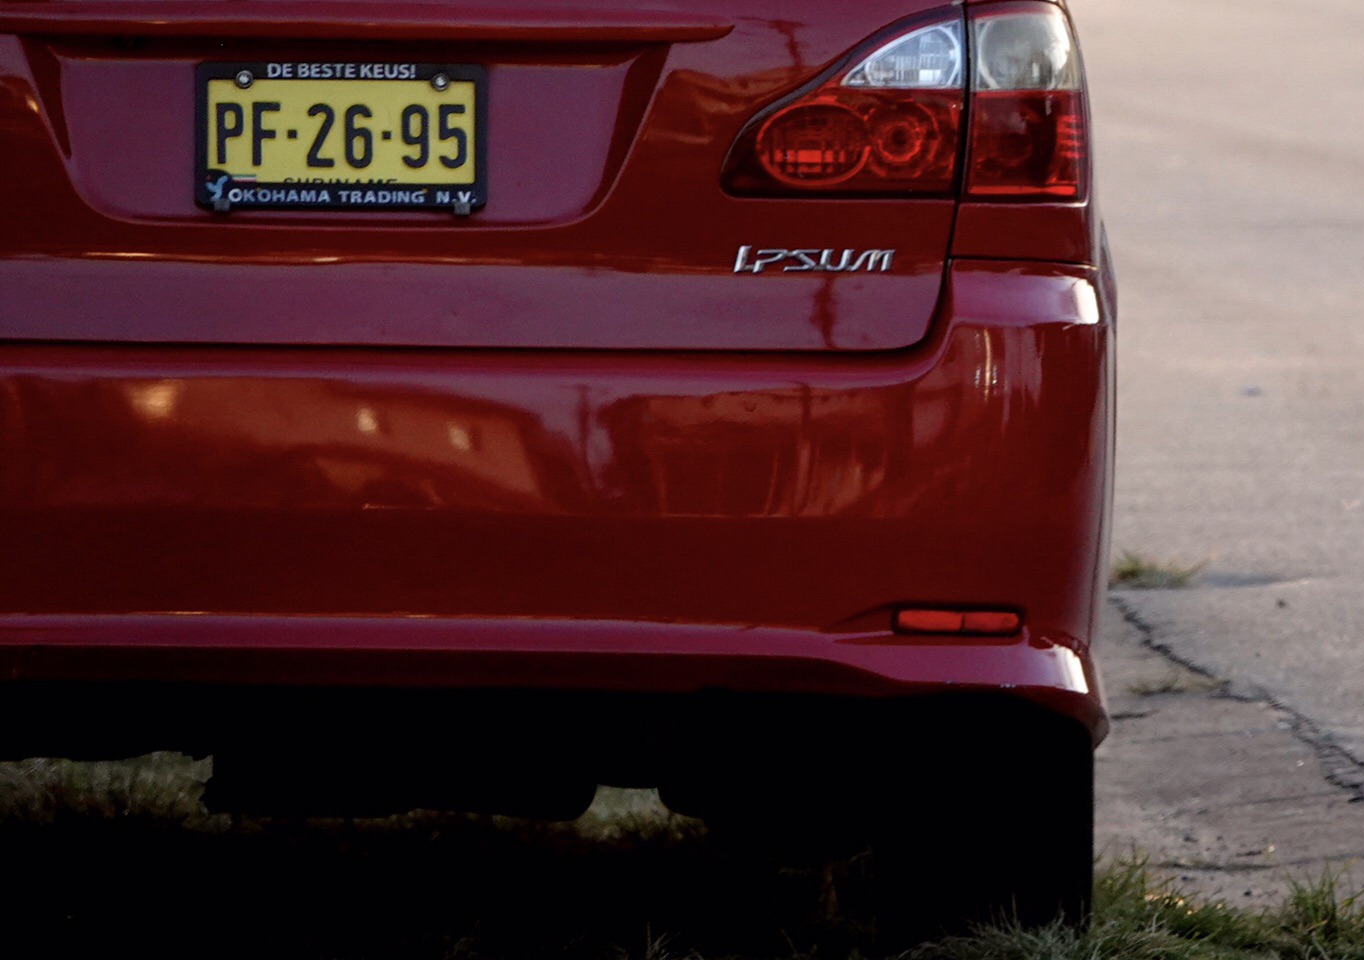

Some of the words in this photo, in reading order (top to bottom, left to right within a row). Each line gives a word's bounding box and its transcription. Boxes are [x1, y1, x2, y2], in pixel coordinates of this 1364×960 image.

[267, 63, 292, 78] DE
[298, 63, 355, 79] BESTE
[360, 63, 417, 79] KEUS!
[338, 190, 425, 204] TRADING
[436, 190, 477, 204] N.V.
